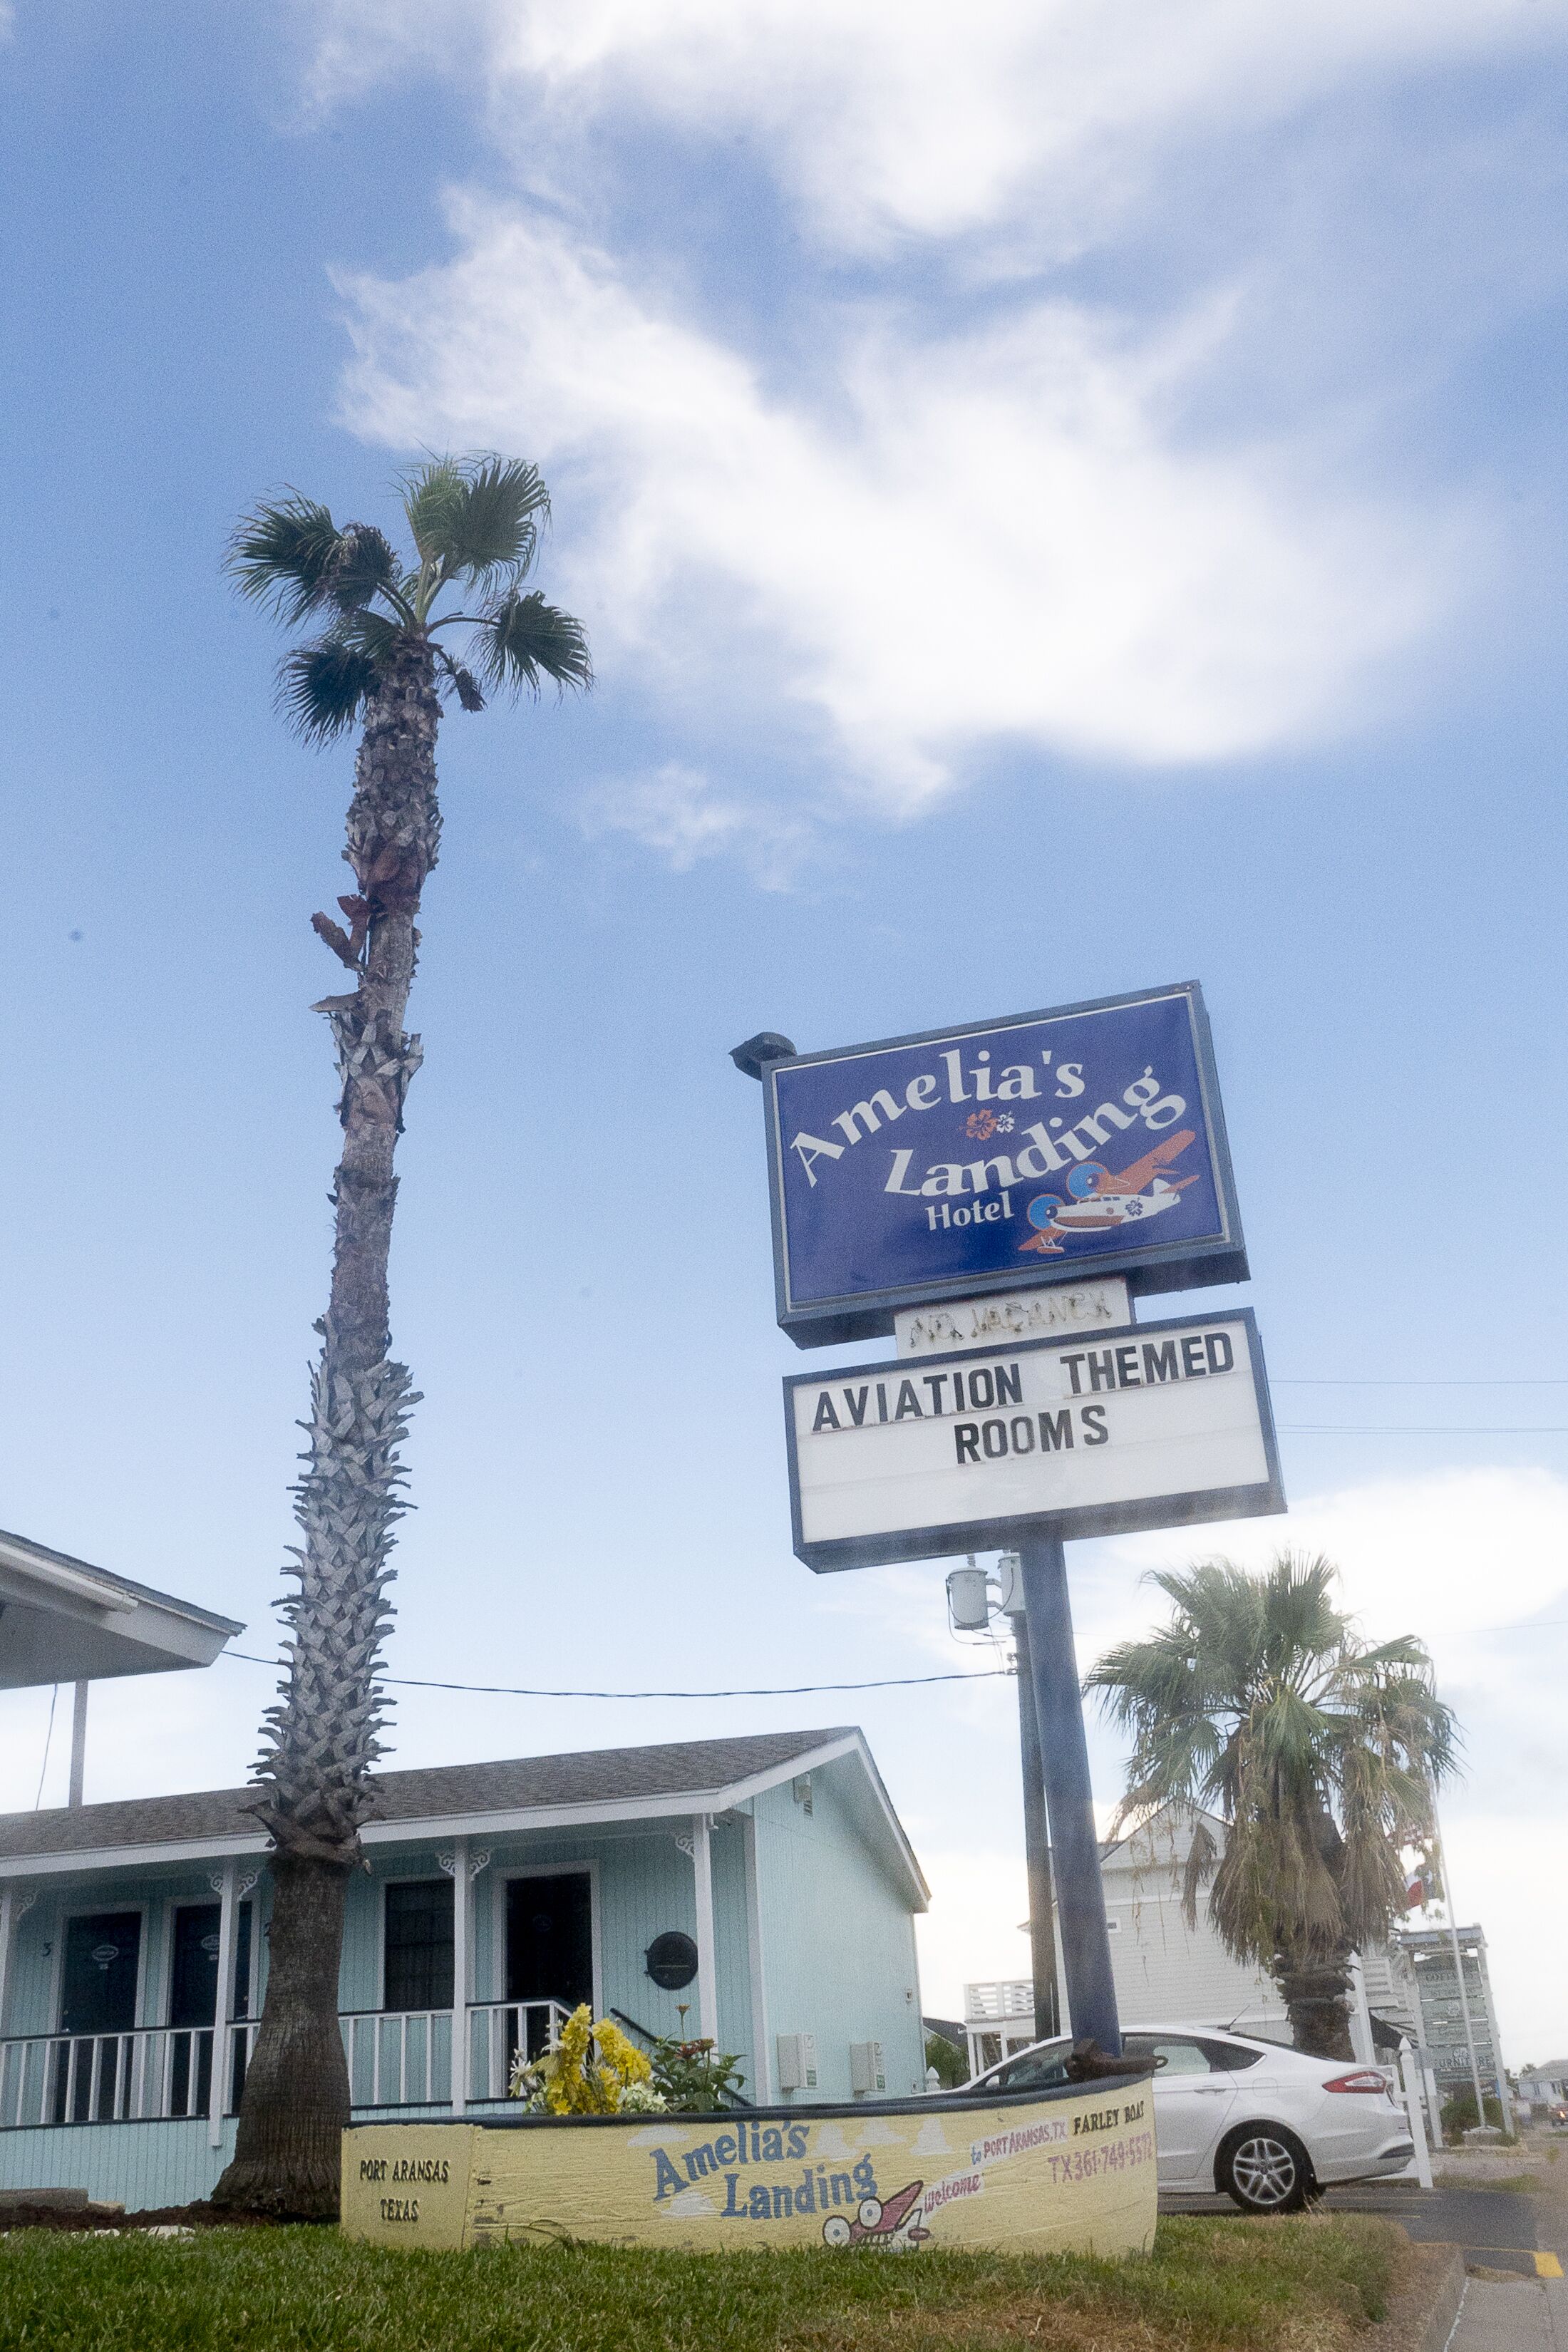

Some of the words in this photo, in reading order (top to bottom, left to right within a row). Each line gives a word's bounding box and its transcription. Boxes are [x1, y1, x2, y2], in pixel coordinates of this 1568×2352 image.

[790, 1049, 1085, 1187] Amelia's
[883, 1065, 1187, 1197] Landing
[925, 1188, 1015, 1232] Hotel
[813, 1363, 1023, 1433] AVIATION
[1060, 1331, 1235, 1397] THEMED
[954, 1404, 1110, 1465] ROOMS
[42, 1942, 51, 1957] 3
[1073, 2108, 1120, 2136] FARLEY
[1124, 2100, 1145, 2123] BOAT
[359, 2159, 388, 2182] PORT
[392, 2159, 450, 2183] ARANSAS
[649, 2120, 810, 2202] Amelia's
[971, 2145, 982, 2165] to
[984, 2135, 1009, 2159] PORT
[380, 2198, 419, 2222] TEXAS
[720, 2152, 878, 2220] Landing
